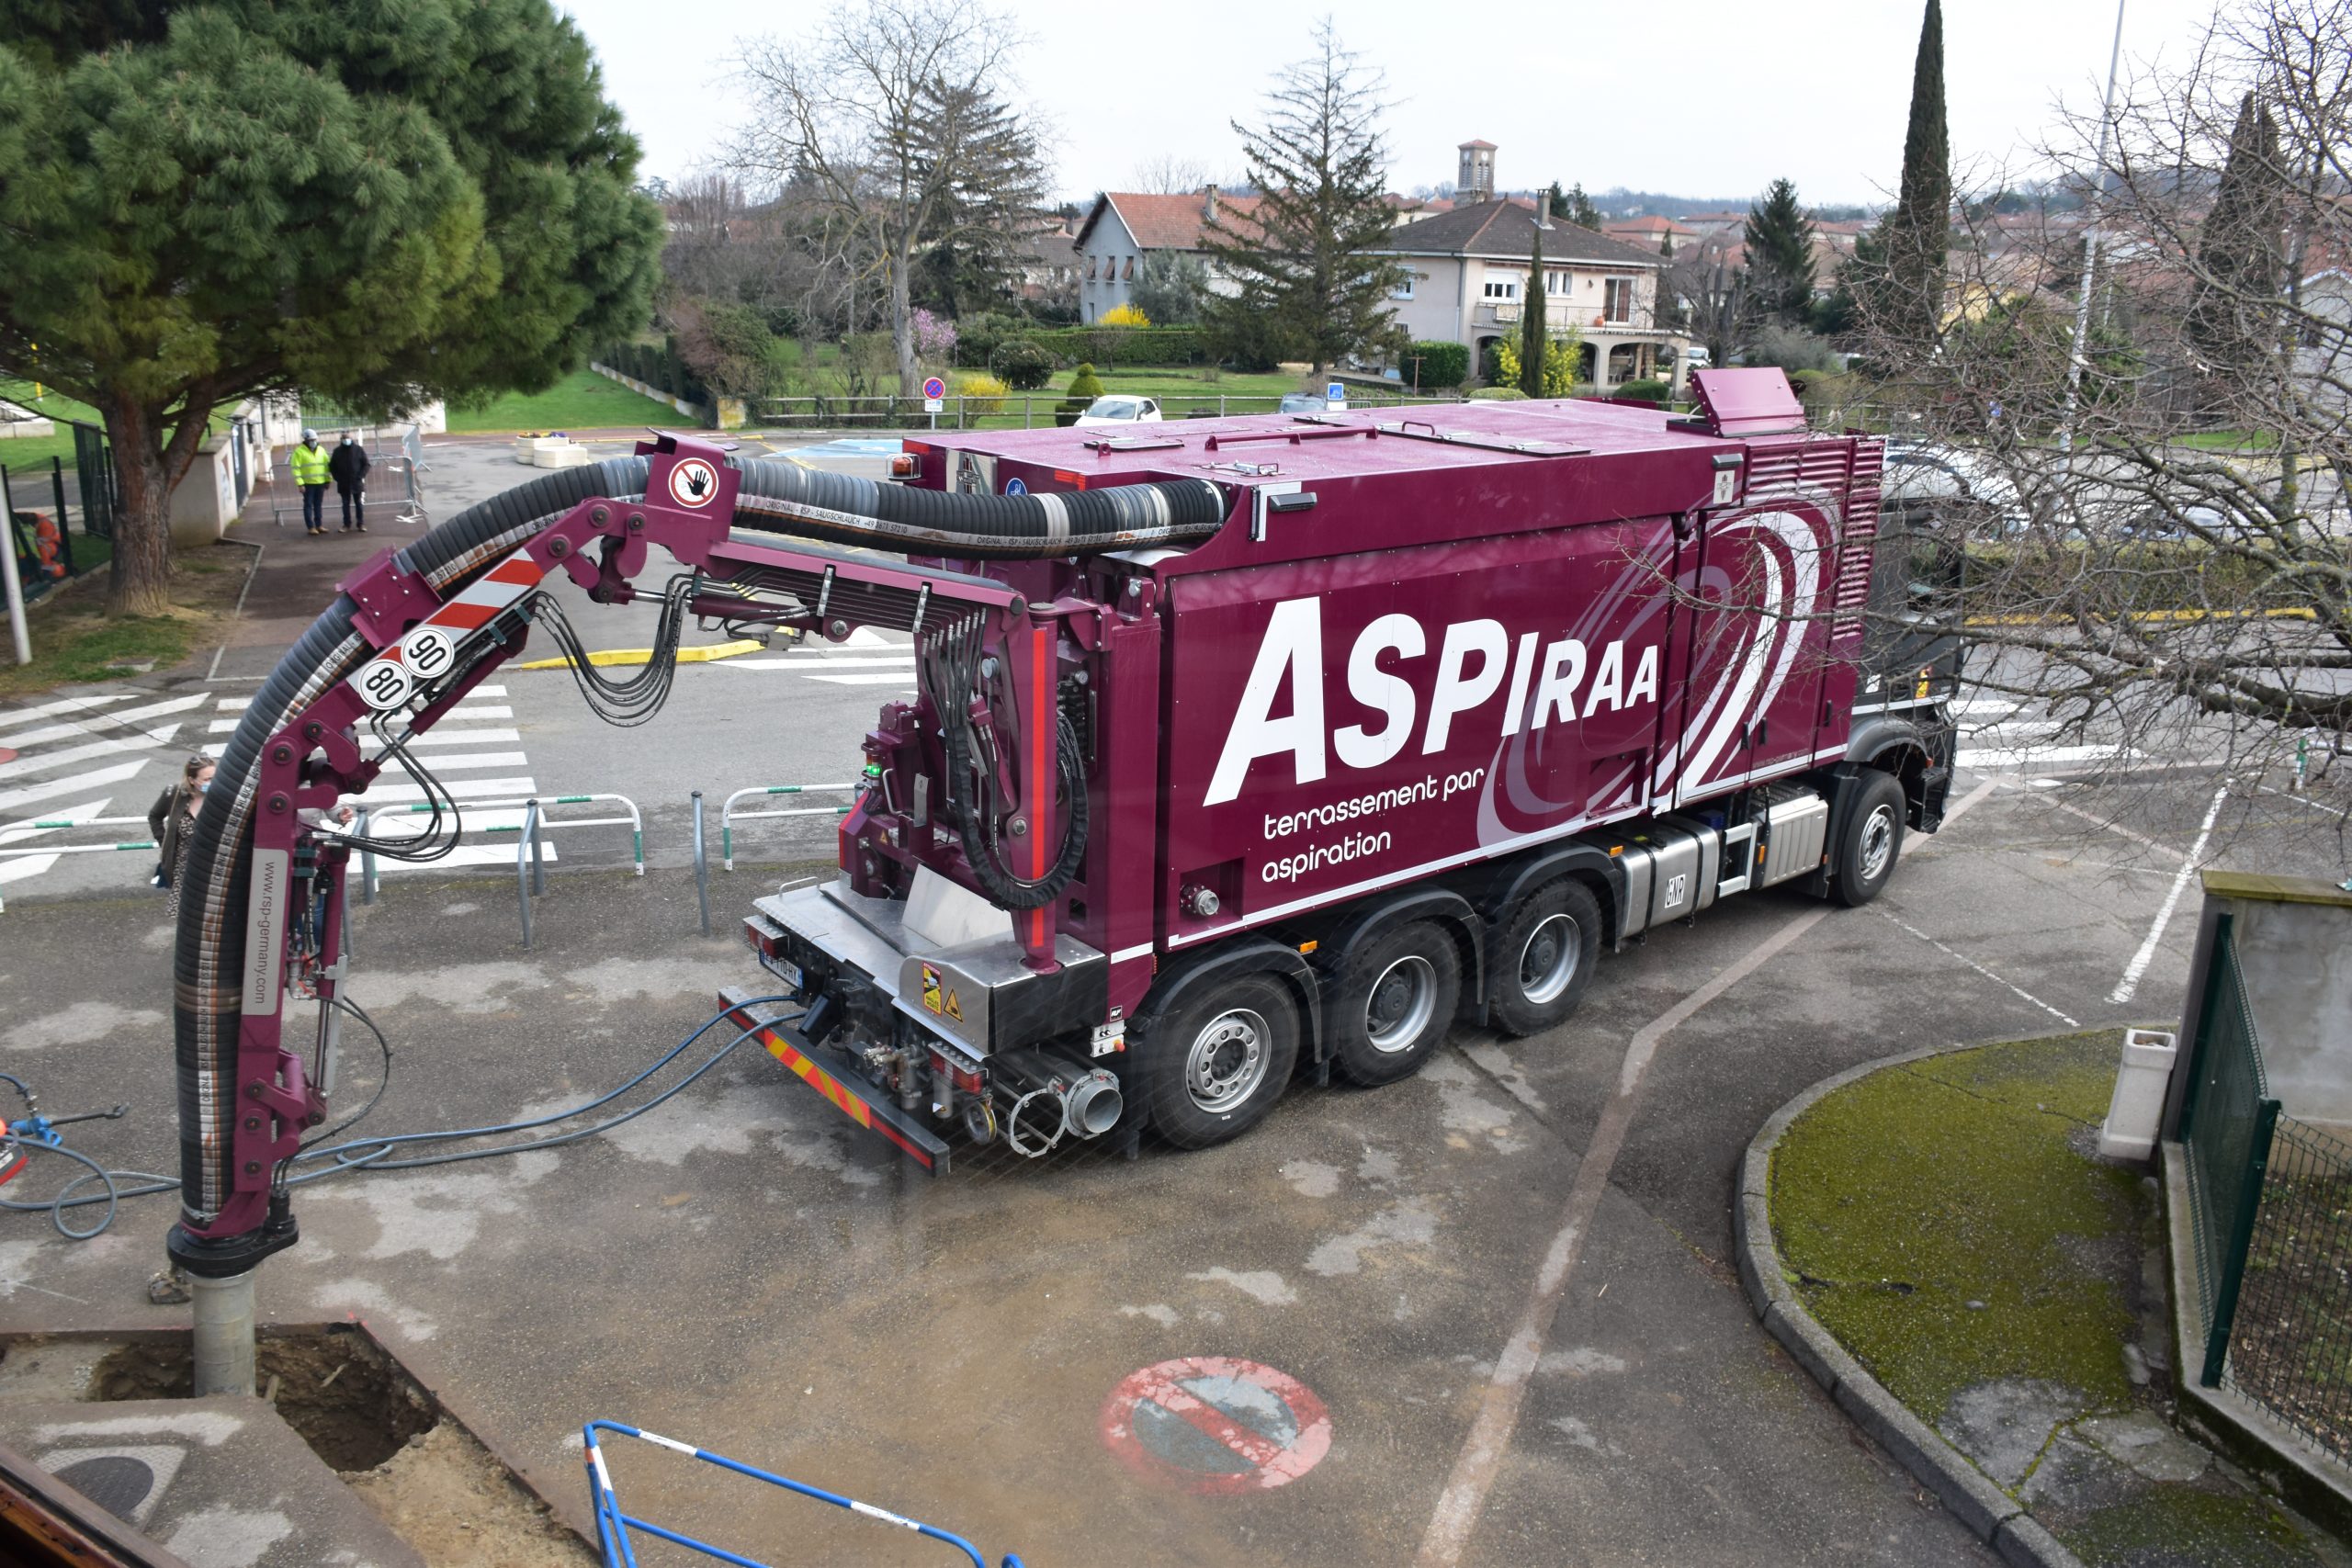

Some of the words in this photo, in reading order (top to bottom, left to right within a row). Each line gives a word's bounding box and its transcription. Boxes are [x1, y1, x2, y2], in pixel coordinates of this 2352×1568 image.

[765, 499, 793, 513] ORIGINAL
[409, 635, 447, 671] 90
[366, 667, 404, 703] 80
[1203, 596, 1658, 807] ASPIRAA
[1263, 775, 1439, 840] terrassement
[1442, 767, 1485, 802] par
[1261, 830, 1392, 883] aspiration
[1666, 876, 1684, 907] GNR
[255, 861, 275, 1004] www.rsp-germany.com
